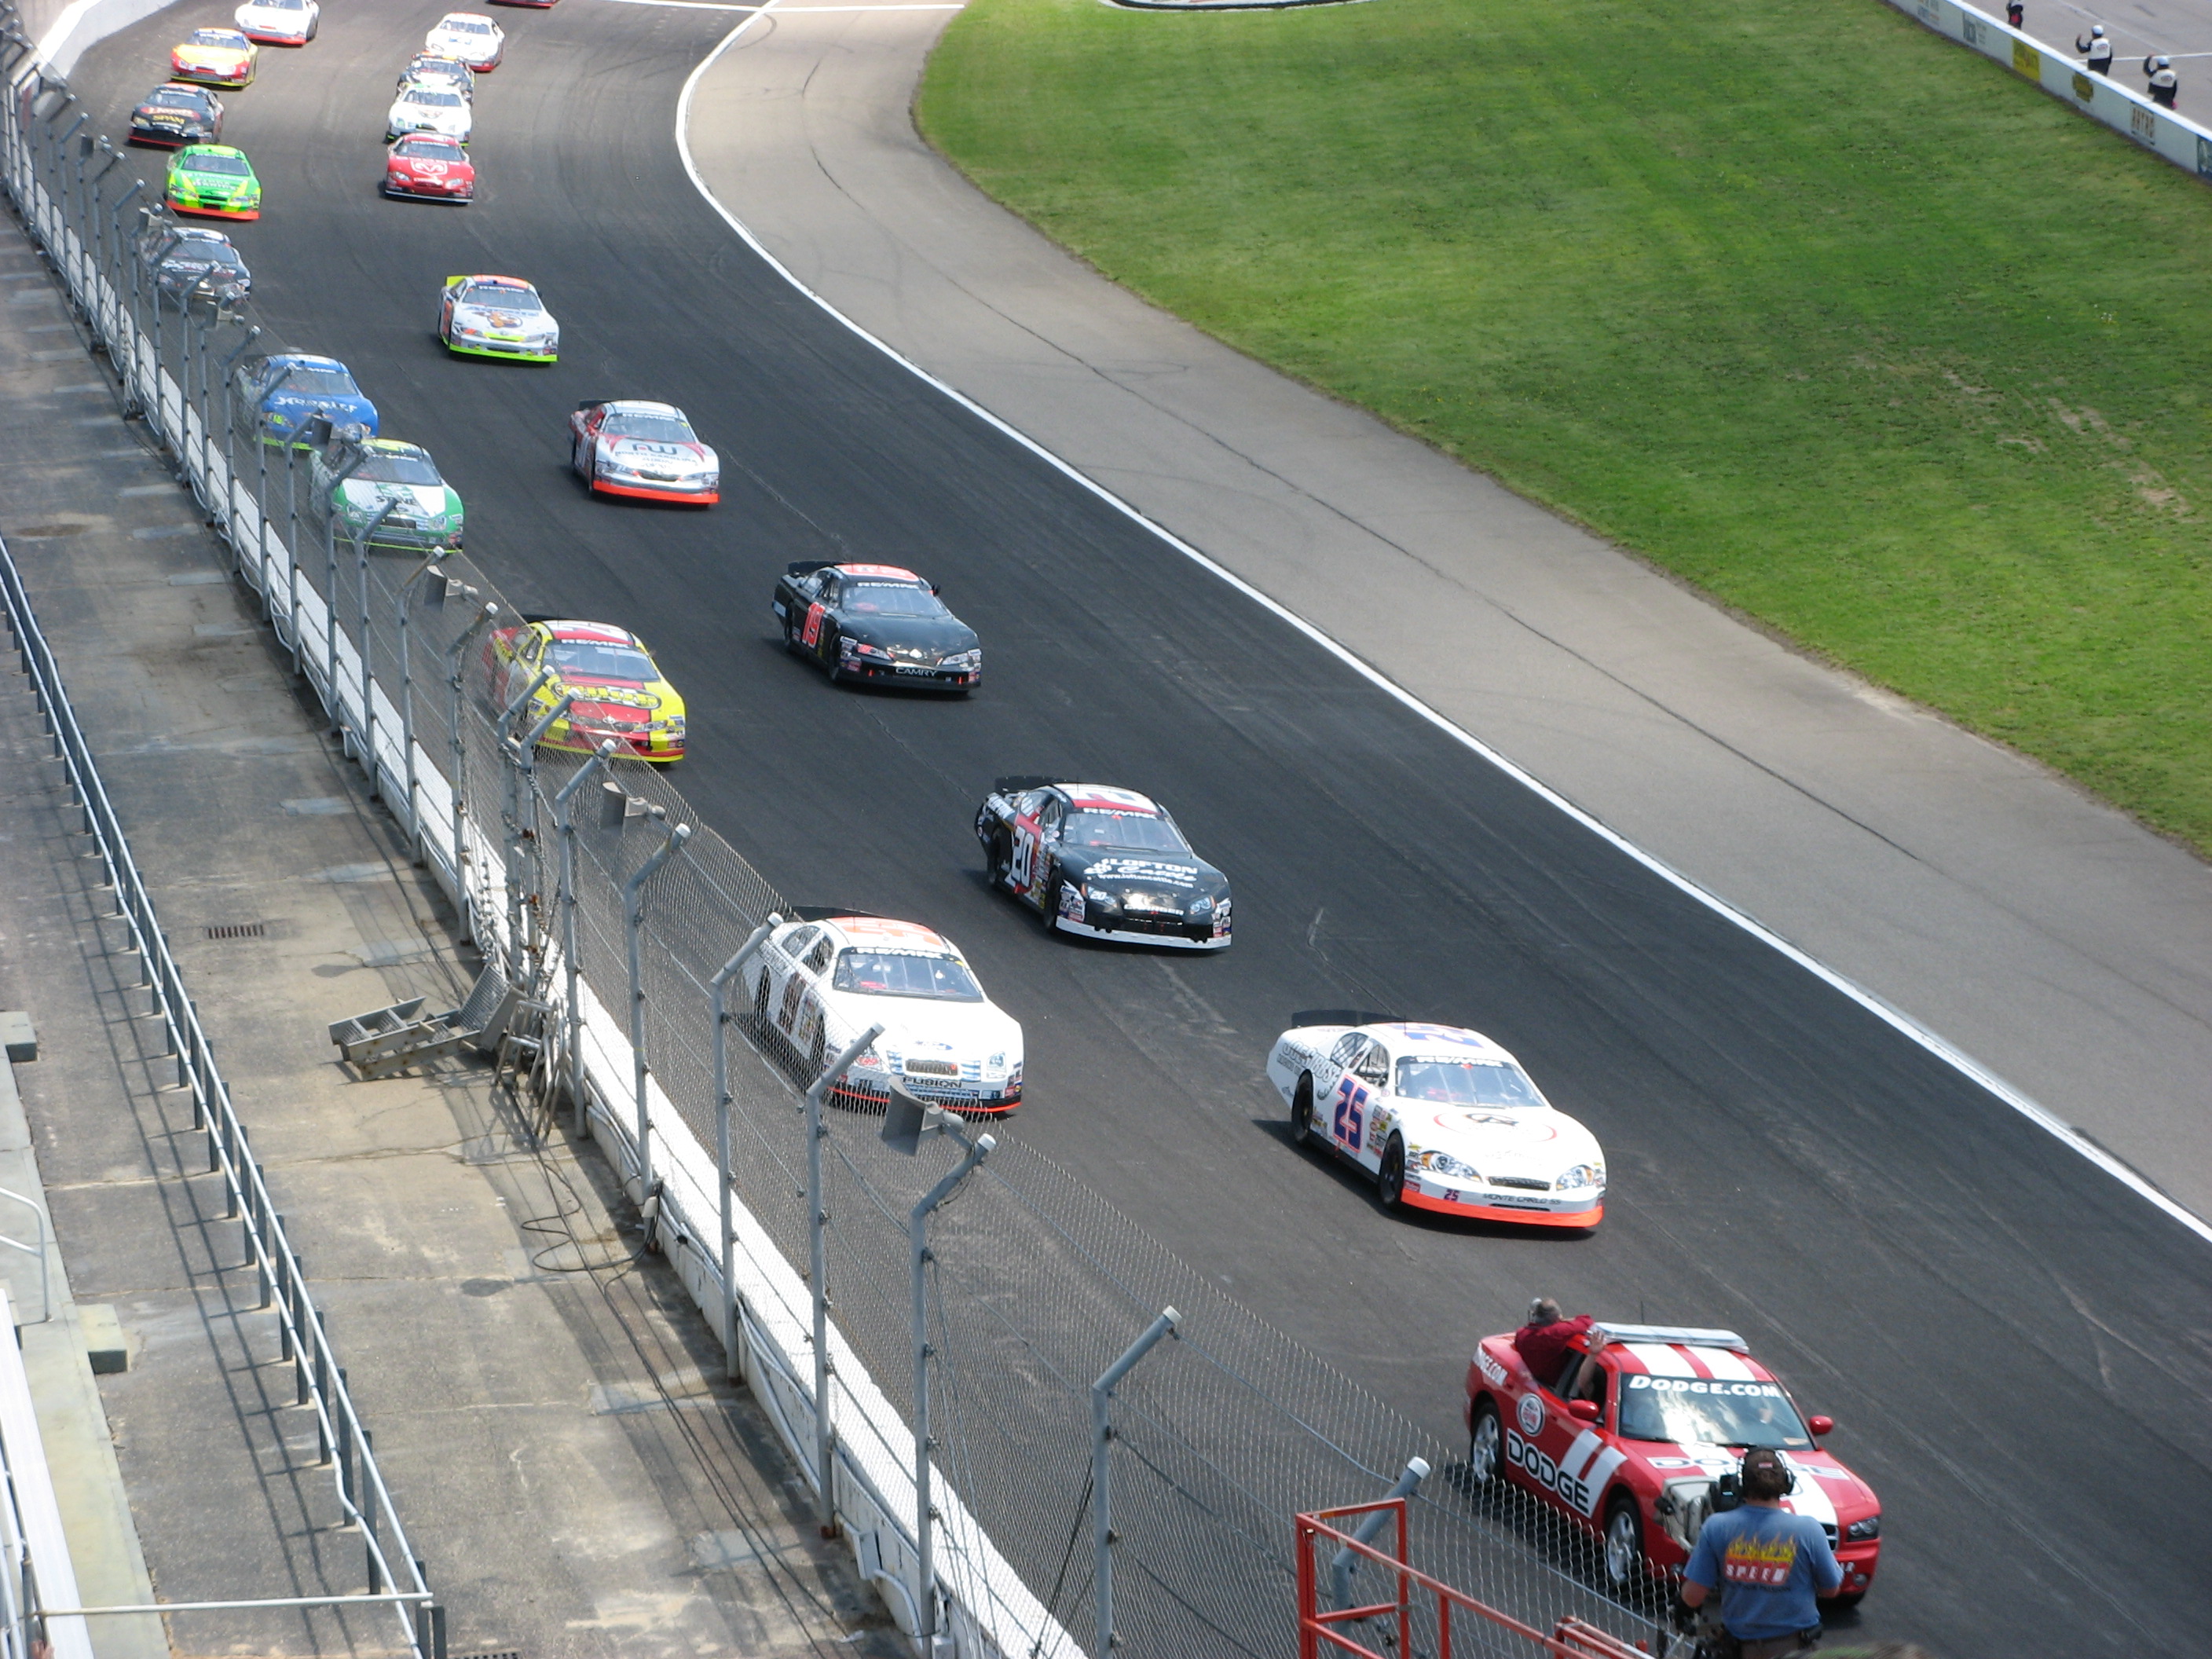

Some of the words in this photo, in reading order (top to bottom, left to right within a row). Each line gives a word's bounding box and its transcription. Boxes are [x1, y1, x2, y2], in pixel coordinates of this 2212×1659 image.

[895, 667, 937, 677] CAMRY
[1010, 826, 1035, 888] 20
[1110, 859, 1198, 873] LOFTON
[1090, 891, 1107, 900] 20
[1123, 903, 1185, 916] CHARGER
[903, 1077, 962, 1089] FUSION
[1333, 1074, 1371, 1153] 25
[1444, 1188, 1459, 1201] 25
[1483, 1192, 1514, 1202] MONTE
[1517, 1196, 1547, 1204] CARLO
[1629, 1375, 1781, 1398] DODGE.COM
[1507, 1430, 1591, 1516] DODGE
[1726, 1563, 1786, 1583] SPEED
